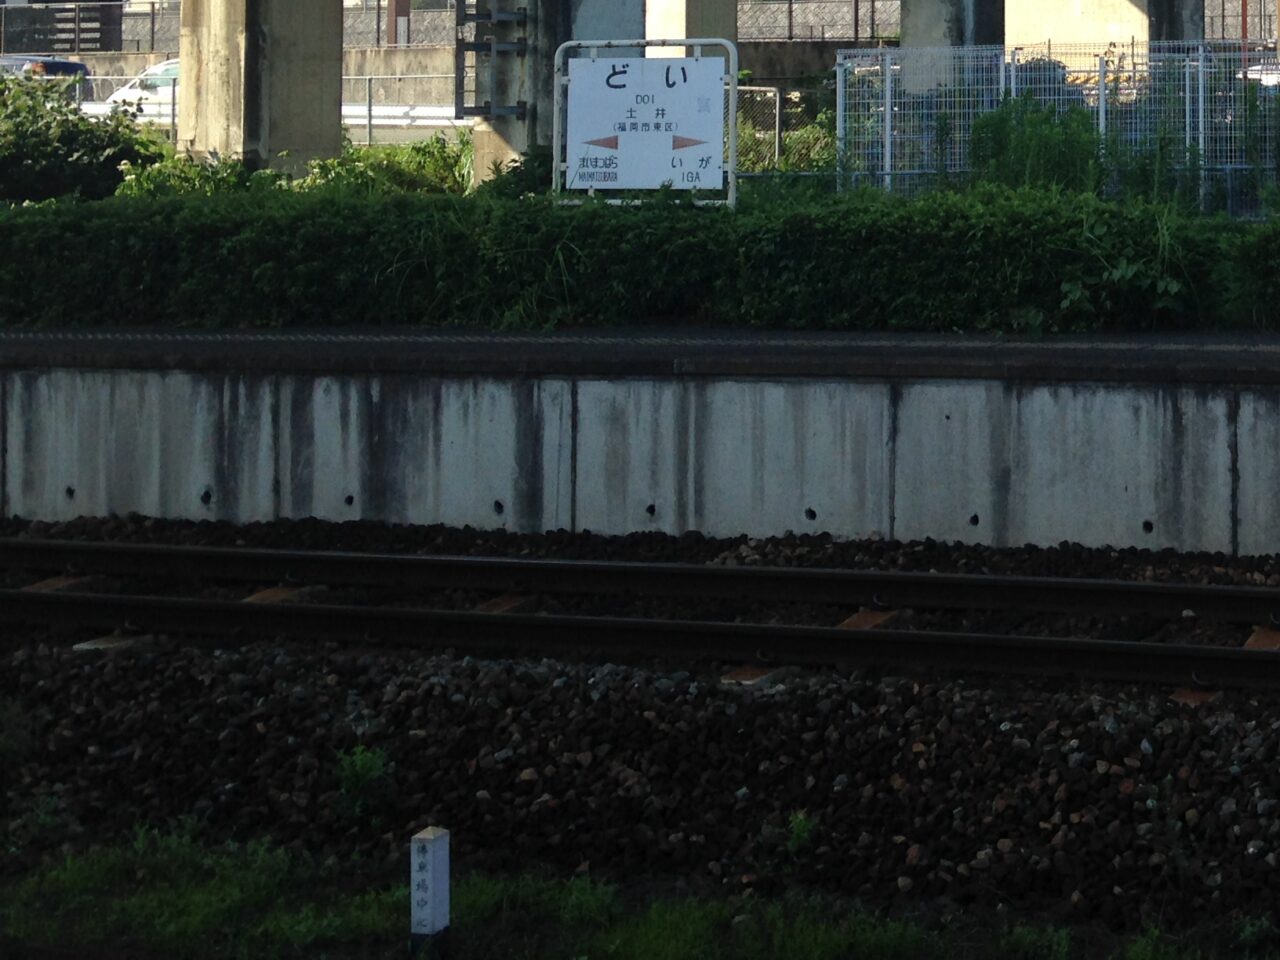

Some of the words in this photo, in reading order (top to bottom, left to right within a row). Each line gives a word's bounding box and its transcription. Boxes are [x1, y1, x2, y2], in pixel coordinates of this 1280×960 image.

[605, 63, 688, 89] どい
[635, 94, 655, 105] DOI
[625, 108, 667, 119] 土井
[671, 156, 712, 169] いが
[681, 171, 701, 182] IGA
